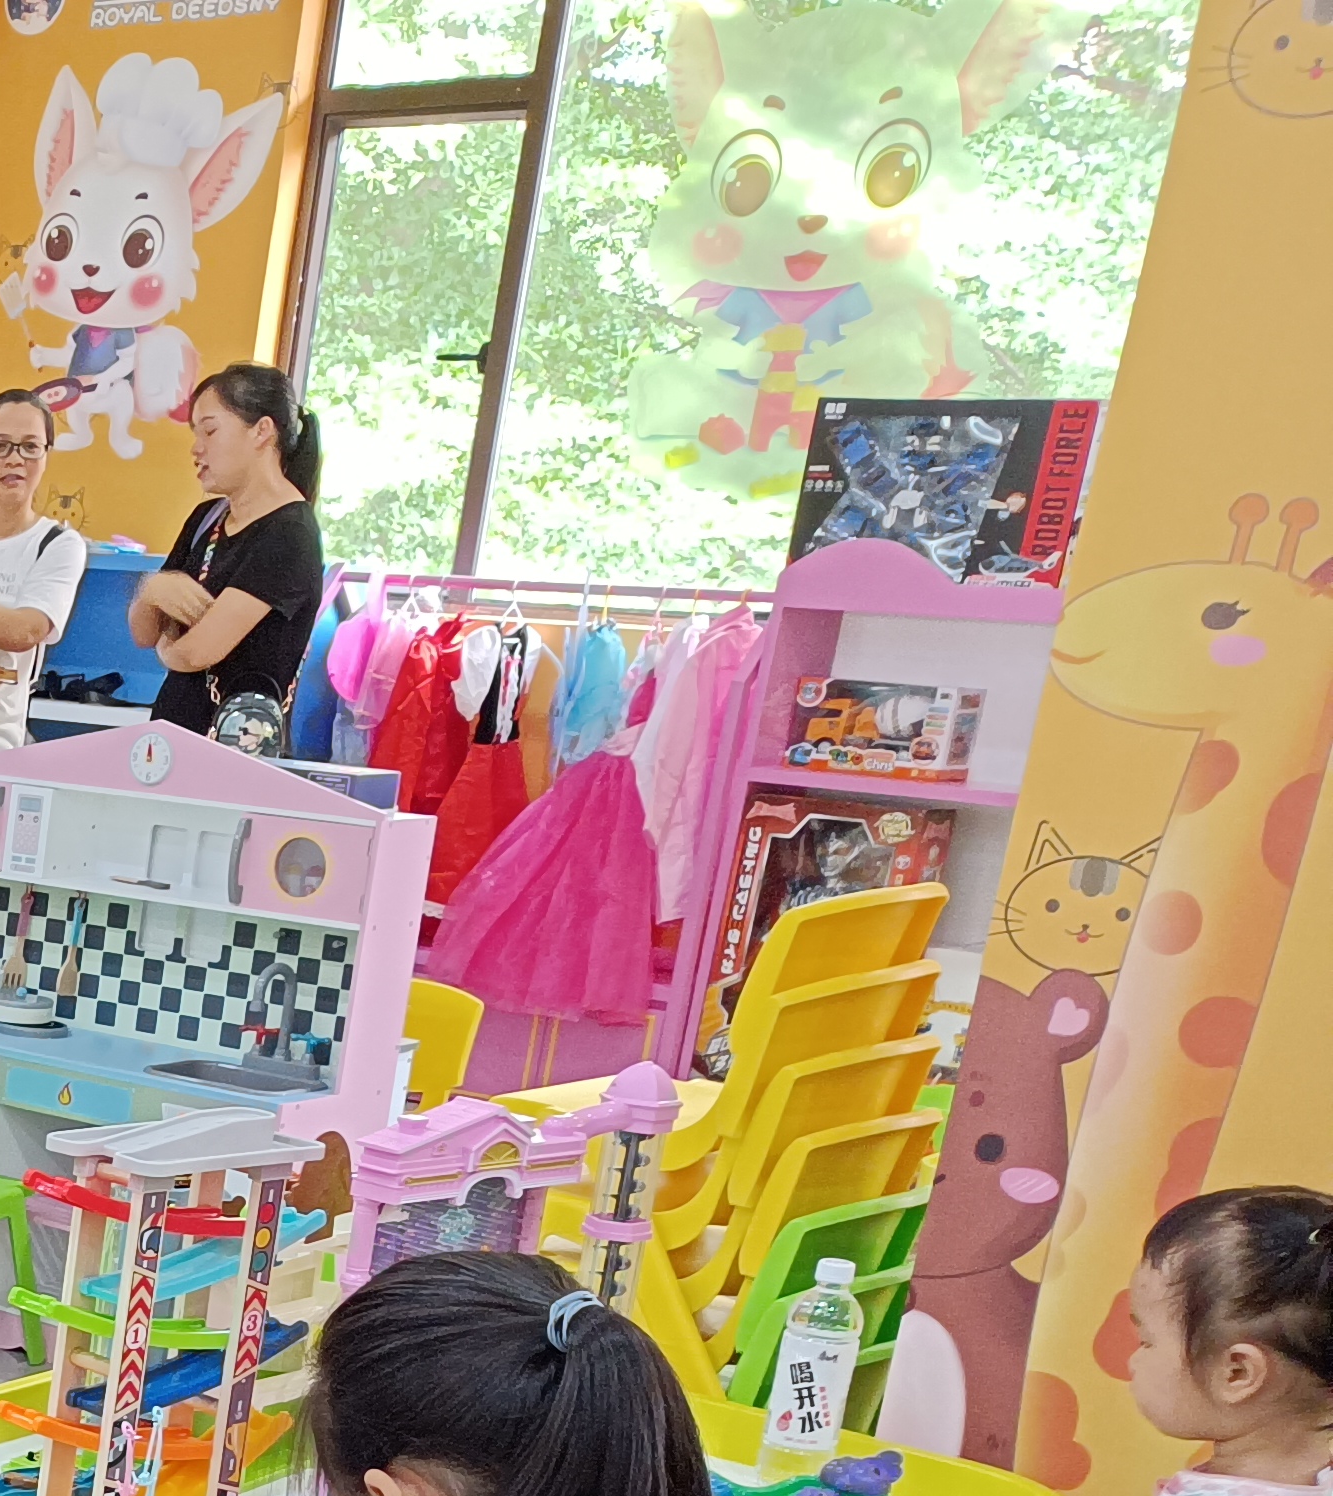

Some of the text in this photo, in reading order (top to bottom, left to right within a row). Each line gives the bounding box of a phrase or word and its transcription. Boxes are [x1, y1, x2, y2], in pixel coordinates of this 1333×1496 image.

[90, 0, 279, 28] ROYAL DEEDSNY
[1031, 406, 1090, 557] ROBOT FORCE
[132, 1328, 141, 1345] 1
[246, 1315, 258, 1332] 3
[789, 1361, 823, 1433] 喝开水
